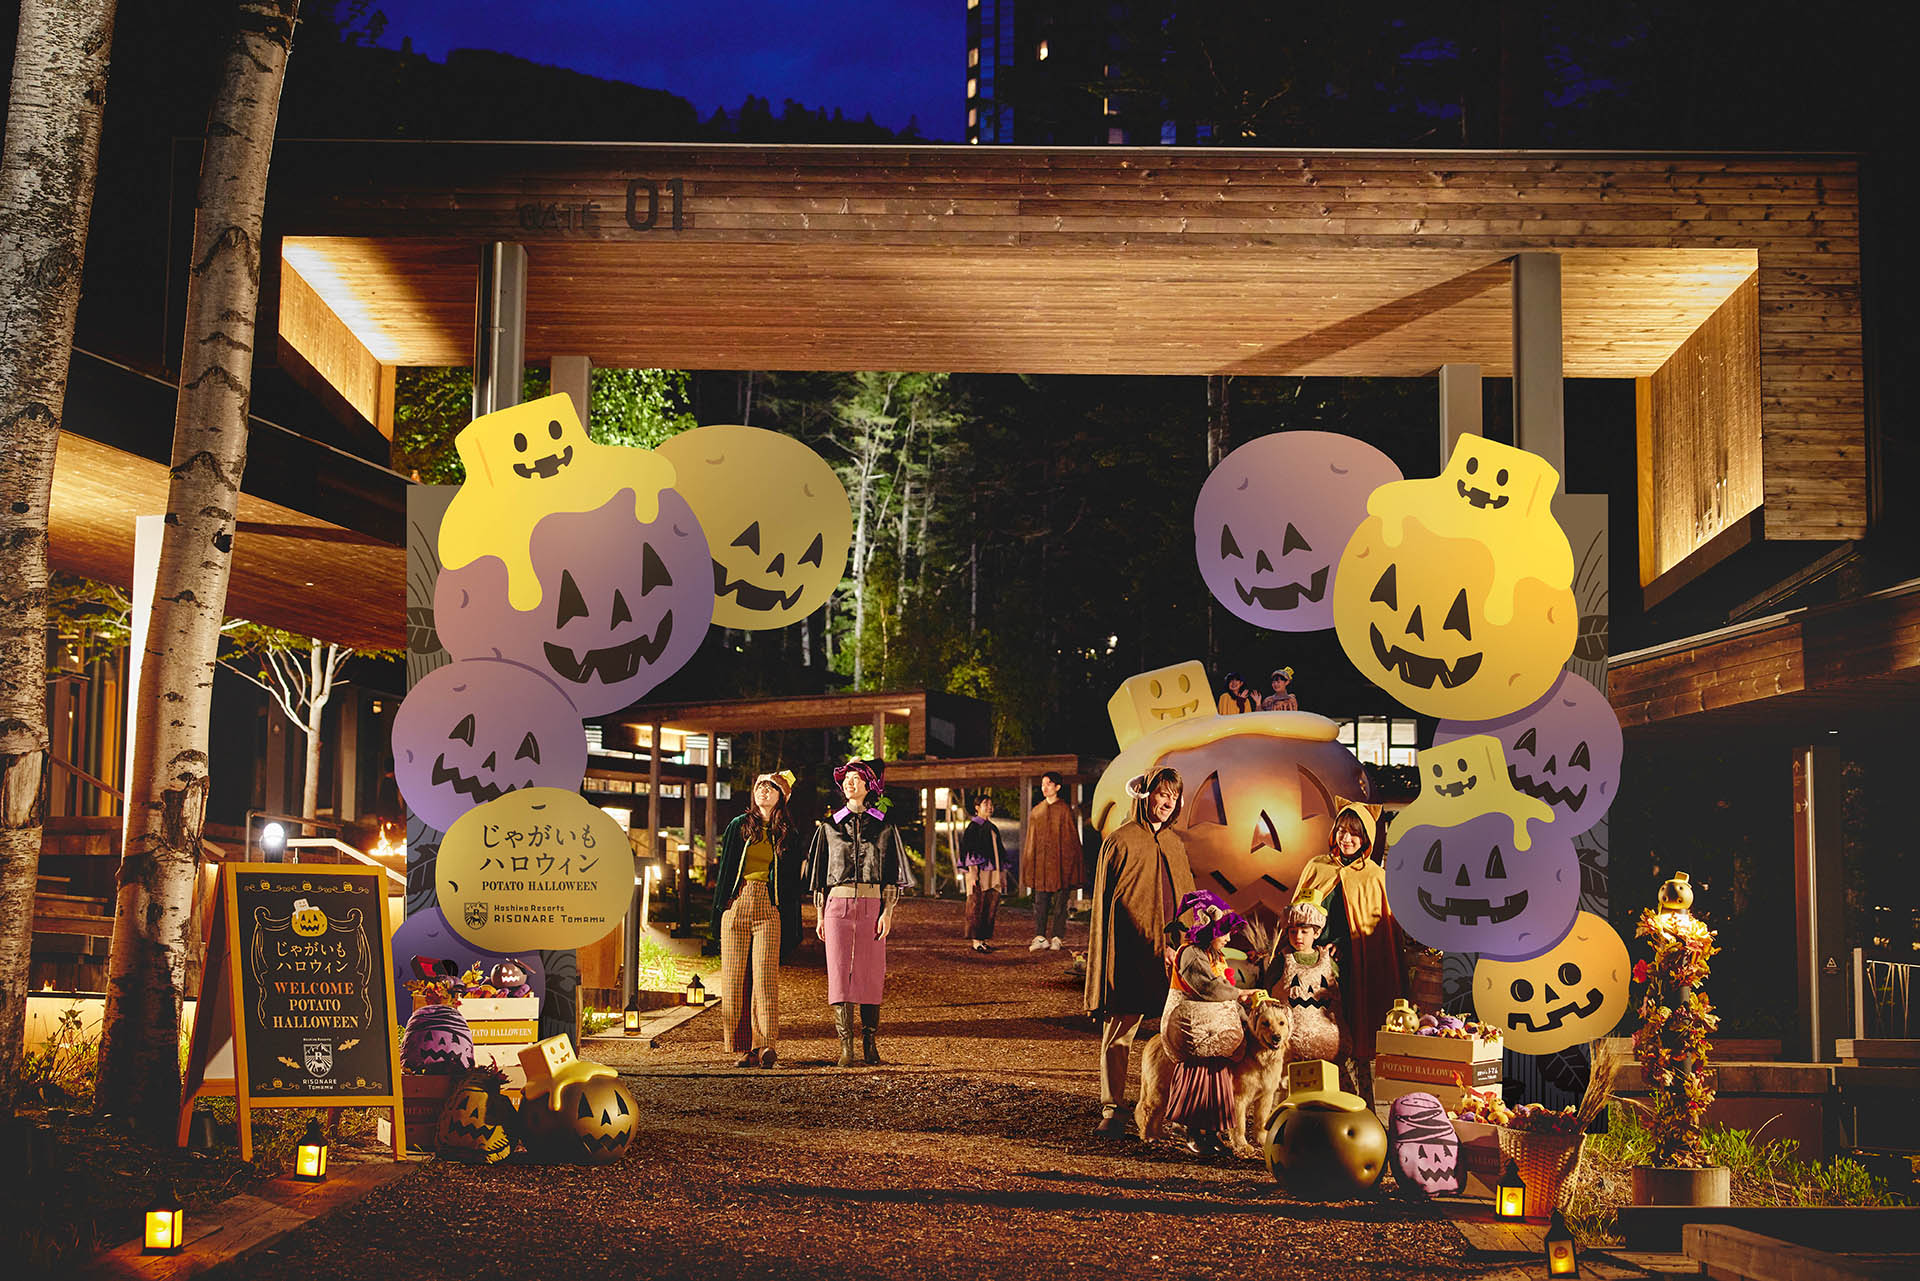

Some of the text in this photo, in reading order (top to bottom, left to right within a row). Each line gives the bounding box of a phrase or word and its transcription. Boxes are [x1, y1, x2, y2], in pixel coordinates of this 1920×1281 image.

[626, 178, 683, 231] 01
[483, 824, 596, 848] じゃがいも
[479, 853, 600, 876] ハロウィン
[482, 881, 598, 891] POTATO HALLOWEEN
[494, 904, 565, 912] Hoshino Resorts
[494, 914, 605, 923] RISONARE Tomamu
[276, 941, 347, 957] じゃがいも
[276, 960, 349, 973] ハロウィン
[274, 982, 354, 995] WELCOME
[289, 999, 341, 1012] POTATO
[273, 1015, 359, 1029] HALLOWEEN
[490, 1028, 532, 1037] HALLOWEEN
[1382, 1063, 1413, 1073] POTATO
